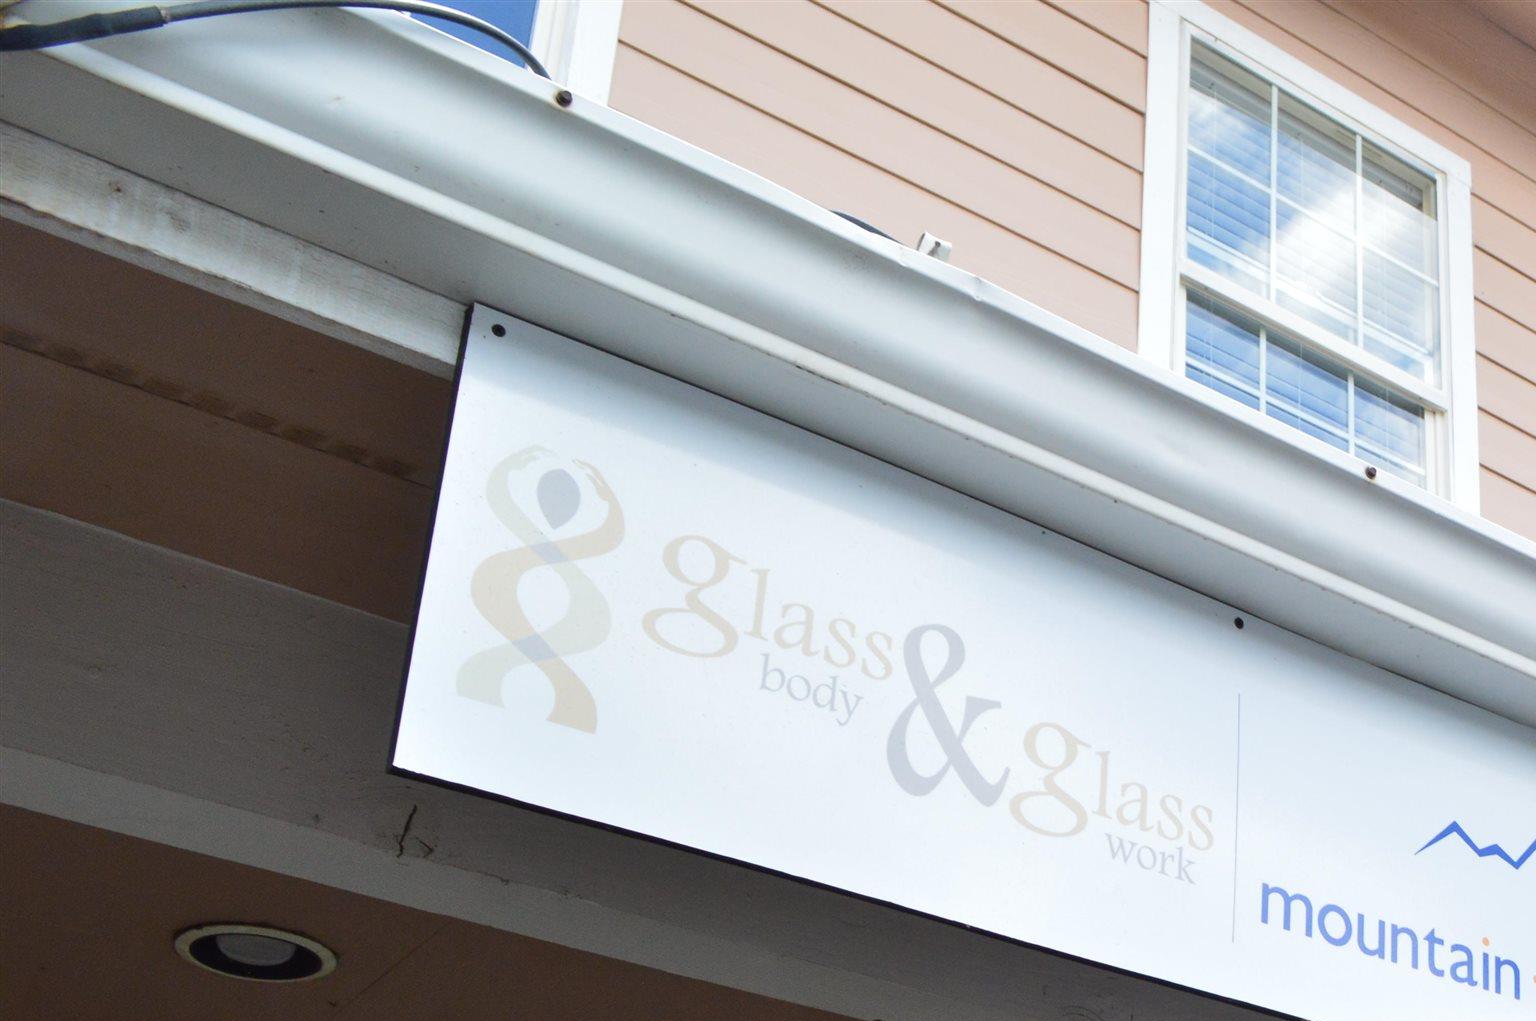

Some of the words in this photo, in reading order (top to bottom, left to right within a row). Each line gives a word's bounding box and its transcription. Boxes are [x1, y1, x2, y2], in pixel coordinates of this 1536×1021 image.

[642, 534, 895, 682] glass
[887, 622, 1010, 808] &
[1008, 721, 1216, 853] glass
[759, 653, 864, 727] body
[1104, 830, 1197, 886] work
[1260, 881, 1521, 1001] mountain
